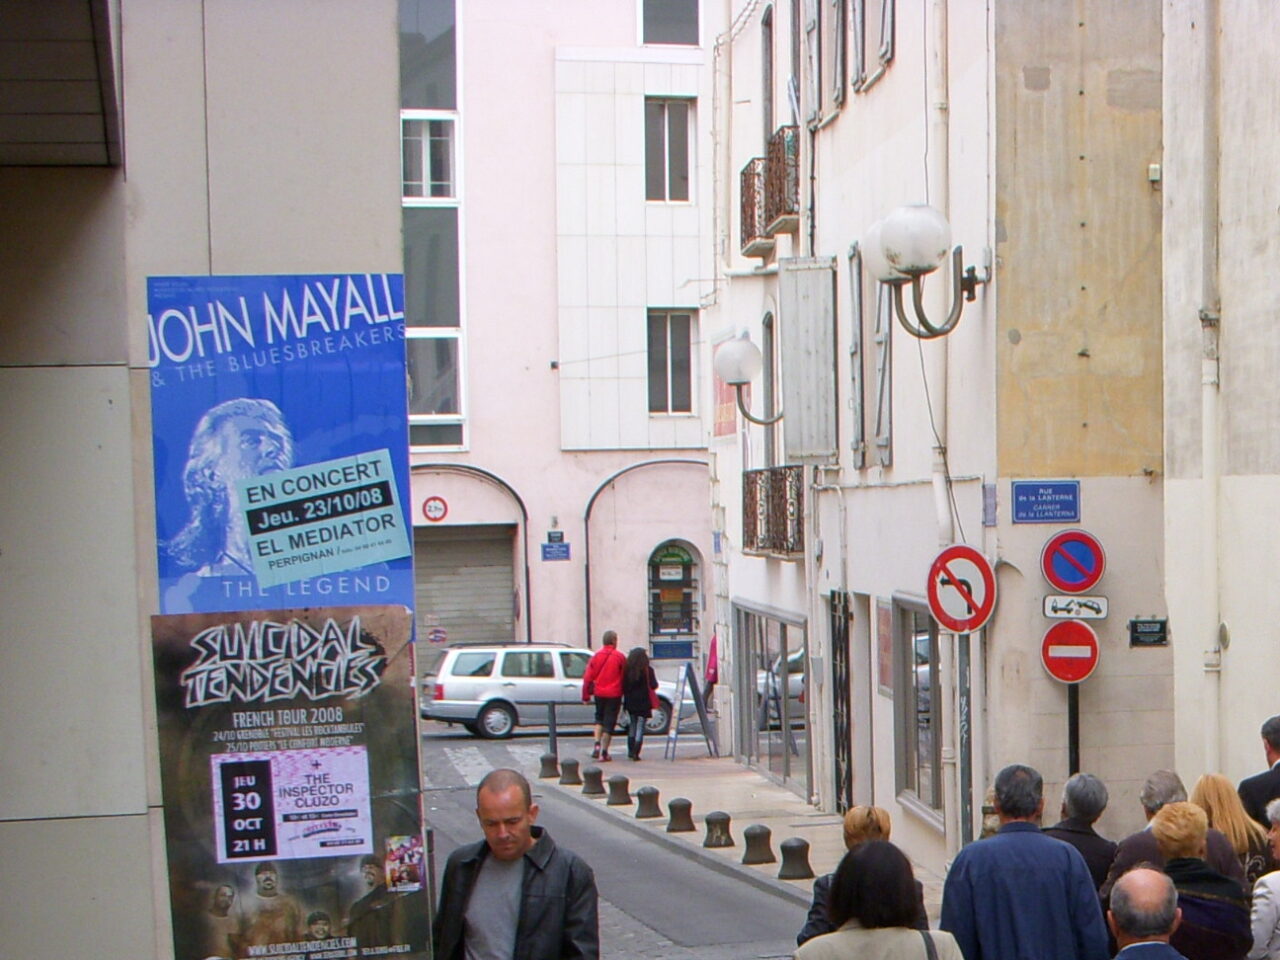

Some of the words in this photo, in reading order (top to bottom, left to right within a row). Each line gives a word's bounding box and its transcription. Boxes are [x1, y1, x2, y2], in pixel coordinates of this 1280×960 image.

[147, 296, 255, 368] JOHN
[263, 273, 404, 344] MAYALL
[152, 371, 165, 387] &
[175, 361, 216, 381] THE
[228, 324, 405, 372] BLUESBREAKERS
[246, 483, 276, 503] EN
[281, 460, 382, 496] CONCERT
[258, 511, 300, 529] Jeu.
[303, 487, 383, 520] 23/10/08
[256, 539, 284, 557] EL
[288, 513, 396, 551] MEDIATOR
[268, 547, 334, 570] PERPIGNAN
[287, 576, 391, 596] LEGEND
[190, 615, 377, 668] SUICIDAL
[181, 652, 388, 708] TENDENCIES
[232, 710, 275, 728] FRENCH
[278, 708, 308, 726] TOUR
[310, 706, 343, 724] 2008
[234, 775, 256, 788] JEU
[304, 773, 331, 785] THE
[232, 791, 261, 811] 30
[279, 783, 354, 798] INSPECTOR
[294, 795, 340, 809] CLUZO
[233, 817, 264, 831] OCT
[233, 839, 250, 852] 21
[254, 838, 266, 851] H
